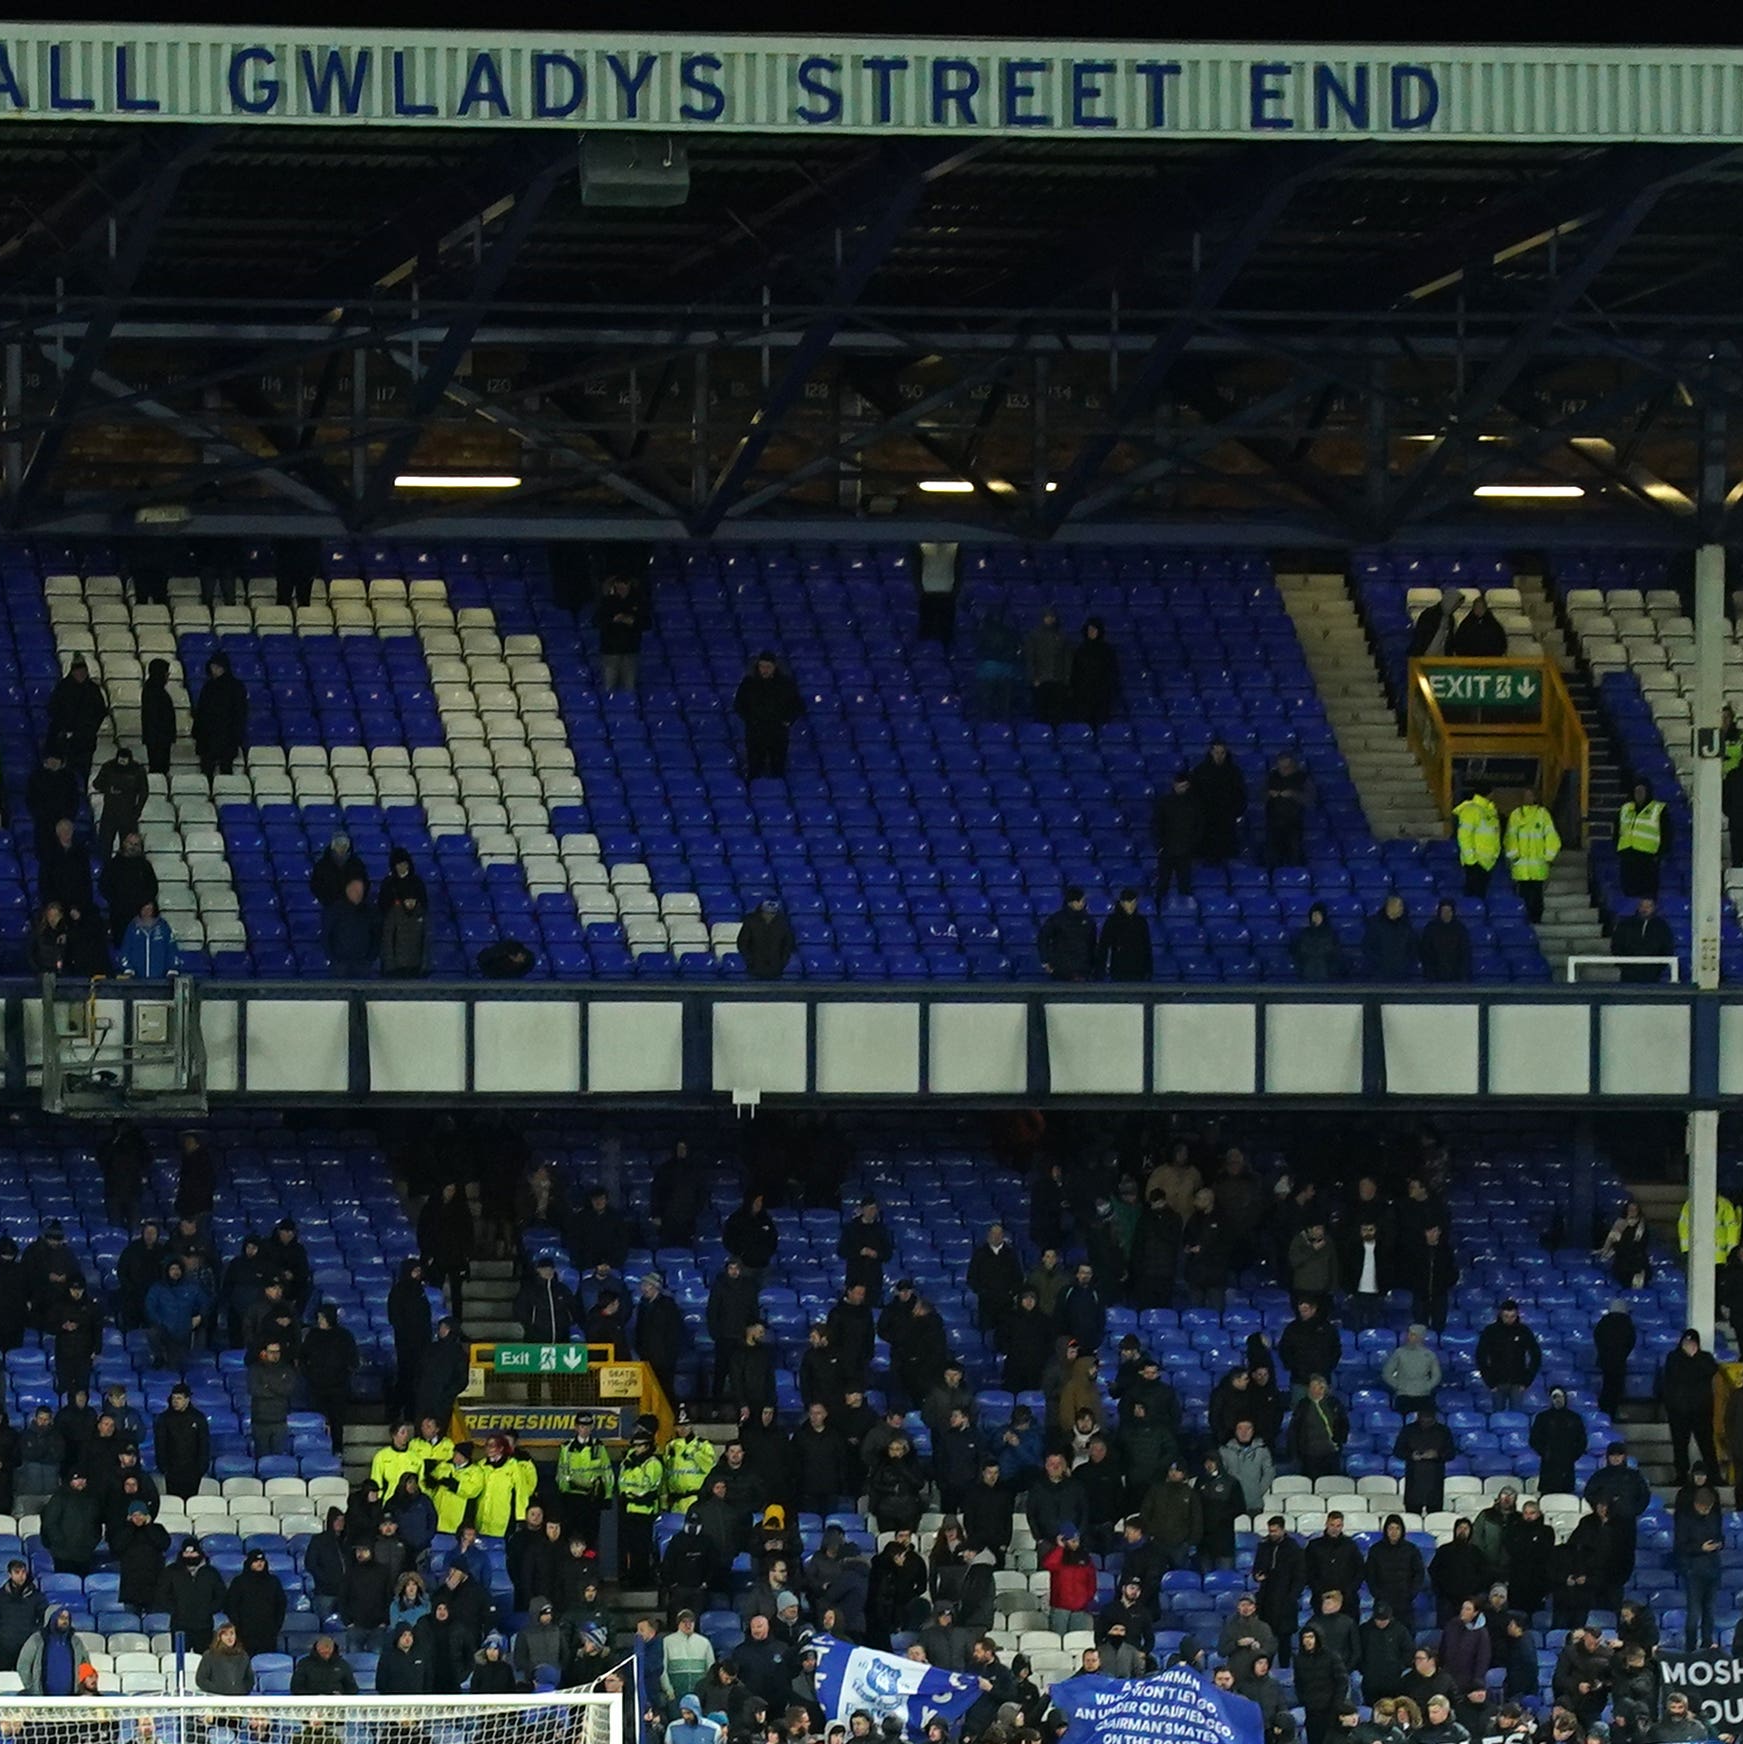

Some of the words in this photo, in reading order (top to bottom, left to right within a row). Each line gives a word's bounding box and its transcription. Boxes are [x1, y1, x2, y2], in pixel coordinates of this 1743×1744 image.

[227, 47, 728, 121] GWLADYS
[794, 56, 1183, 129] STREET
[1248, 63, 1441, 130] END
[375, 387, 397, 402] 117
[1430, 674, 1492, 700] EXIT
[1702, 728, 1720, 757] J
[500, 1351, 530, 1366] Exit
[464, 1414, 619, 1431] REFRESHMTS
[1132, 1685, 1175, 1701] WON'T
[1075, 1707, 1096, 1721] AN
